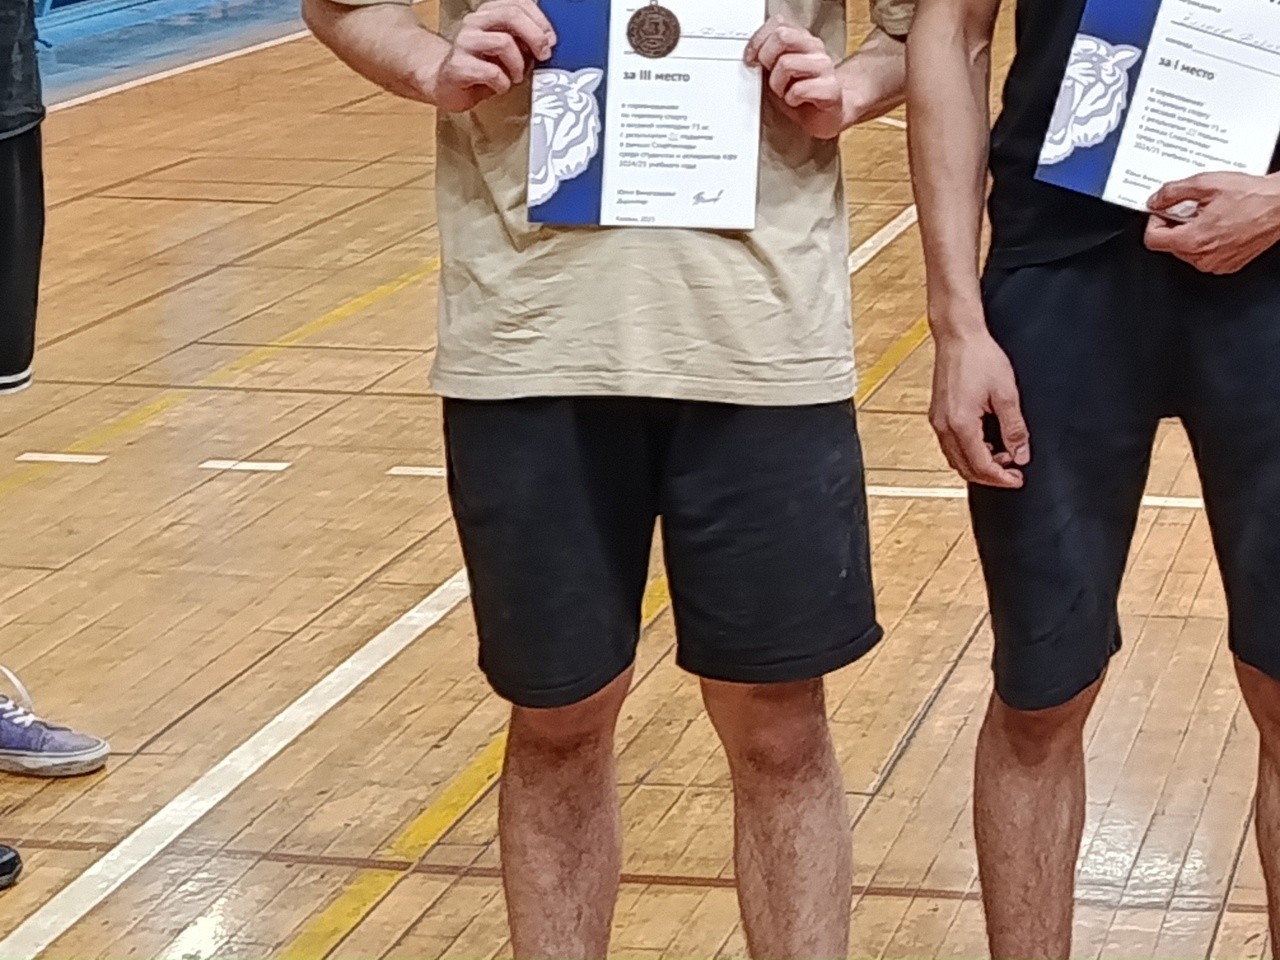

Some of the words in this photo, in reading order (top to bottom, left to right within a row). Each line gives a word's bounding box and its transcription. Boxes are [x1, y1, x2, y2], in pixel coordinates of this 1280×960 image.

[623, 71, 636, 80] за
[639, 69, 652, 81] III
[654, 72, 691, 82] место
[1158, 56, 1172, 67] за
[1180, 63, 1215, 81] место
